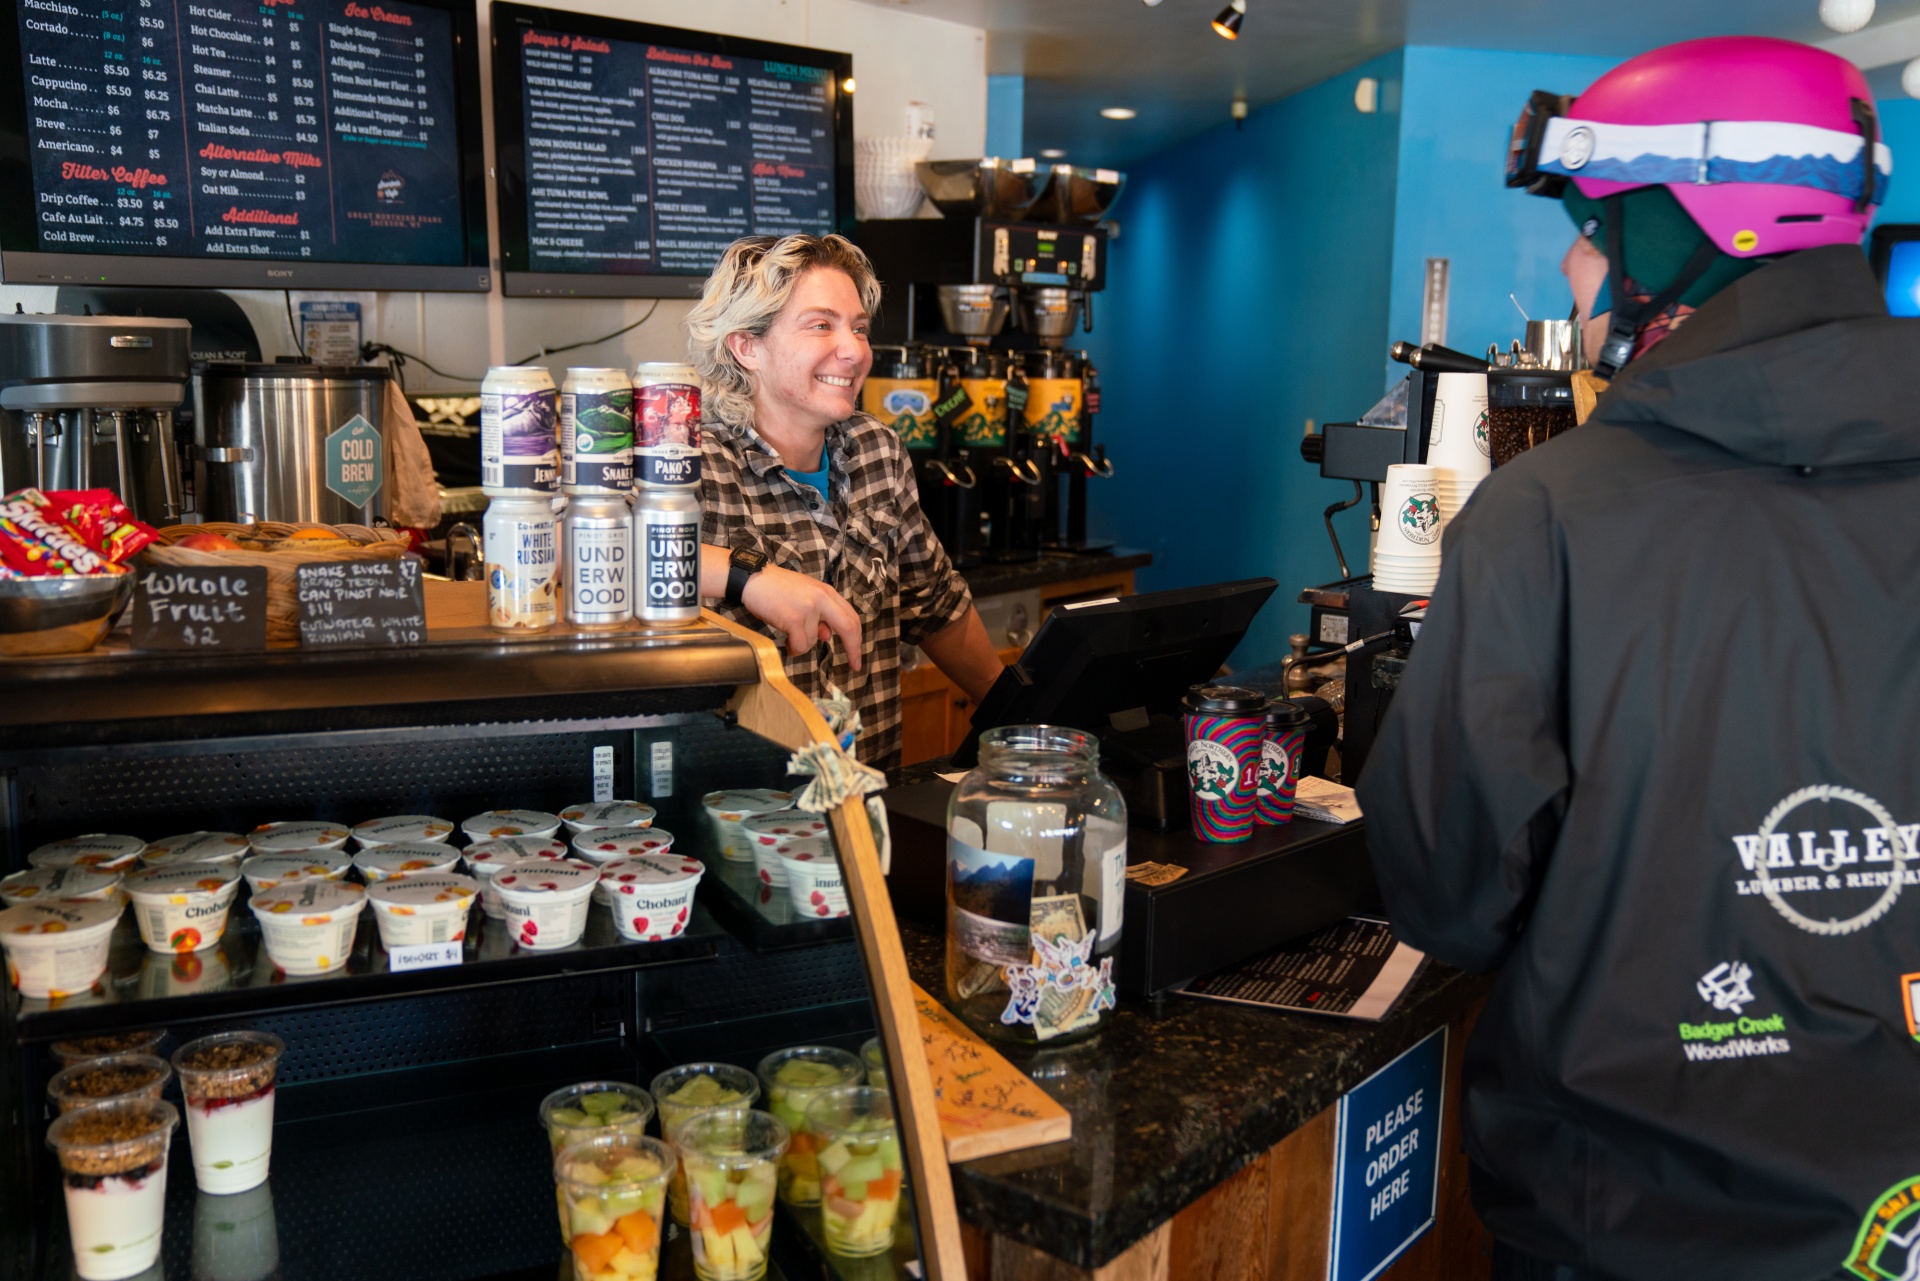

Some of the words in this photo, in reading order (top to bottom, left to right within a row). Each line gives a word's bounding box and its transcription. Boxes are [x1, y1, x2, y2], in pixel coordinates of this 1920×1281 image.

[24, 0, 79, 16] Macchiato
[140, 17, 164, 30] $5.50
[190, 5, 206, 16] Hot
[208, 8, 233, 21] Cider
[26, 20, 68, 35] Cortado
[142, 37, 154, 48] $6
[190, 25, 208, 36] Hot
[208, 28, 252, 44] Chocolate
[328, 22, 354, 36] Single
[354, 26, 378, 41] Scoop
[192, 44, 209, 56] Hot
[210, 48, 226, 58] Tea
[330, 40, 357, 52] Double
[358, 44, 381, 58] Scoop
[29, 54, 57, 68] Latte
[104, 64, 130, 77] $5.50
[142, 69, 168, 82] $6.25
[194, 63, 232, 78] Steamer
[331, 56, 366, 70] Affogato
[31, 76, 88, 92] Cappucino
[106, 85, 132, 98] $5.50
[144, 90, 170, 102] $6.25
[194, 83, 216, 95] Chai
[217, 86, 240, 98] Latte
[34, 96, 68, 110] Mocha
[108, 105, 120, 116] $6
[146, 110, 170, 122] $6.75
[196, 102, 230, 116] Matcha
[230, 106, 253, 118] Latte
[378, 94, 414, 108] Milkshake
[334, 106, 374, 120] Additional
[36, 118, 66, 130] Breve
[110, 126, 122, 136] $6
[148, 130, 160, 140] $7
[198, 122, 228, 134] Italian
[229, 125, 250, 136] Soda
[38, 138, 95, 154] Americano
[110, 145, 123, 156] $4
[149, 149, 161, 160] $5
[200, 142, 282, 164] Alternative
[62, 161, 110, 181] Filter
[111, 166, 168, 190] Coffee
[200, 166, 218, 179] Soy
[218, 169, 229, 177] or
[230, 169, 264, 181] Almond
[202, 184, 218, 194] Oat
[220, 185, 240, 196] Milk
[40, 192, 64, 206] Drip
[65, 194, 99, 206] Coffee
[117, 198, 144, 210] $3.50
[152, 200, 165, 210] $4
[42, 212, 66, 224] Cafe
[67, 214, 82, 224] Au
[84, 214, 104, 225] Lait
[119, 216, 144, 228] $4.75
[154, 218, 179, 230] $5.50
[222, 206, 299, 226] Additional
[44, 231, 68, 242] Cold
[69, 232, 95, 243] Brew
[156, 236, 168, 246] $5
[205, 225, 223, 236] Add
[224, 226, 248, 237] Extra
[249, 228, 276, 239] Flavor
[206, 243, 224, 254] Add
[226, 244, 248, 254] Extra
[250, 244, 270, 255] Shot
[342, 439, 374, 461] COLD
[342, 462, 374, 483] BREW
[602, 466, 629, 482] SNAKE
[654, 460, 692, 474] PAKO'S
[664, 474, 684, 482] I.P.A.
[579, 532, 604, 540] PINOT
[651, 526, 677, 534] PINOT
[1402, 526, 1430, 543] NORTHERN
[522, 532, 552, 548] WHITE
[650, 540, 696, 558] UND
[579, 546, 625, 562] UND
[299, 564, 346, 580] SNAKE
[352, 562, 393, 576] RIVER
[400, 561, 418, 577] $7
[580, 567, 625, 584] ERW
[650, 560, 696, 578] ERW
[140, 571, 249, 597] Whole
[300, 578, 343, 590] GRAND
[346, 577, 386, 588] TETON
[650, 582, 696, 599] OOD
[299, 589, 330, 602] CAN
[335, 587, 374, 600] PINOT
[378, 587, 408, 600] NOIR
[579, 588, 625, 604] OOD
[148, 598, 246, 624] Fruit
[307, 602, 334, 617] $14
[380, 616, 424, 628] WHITE
[182, 625, 220, 646] $2
[308, 630, 366, 644] RUSSIAN
[387, 630, 420, 643] $10
[1200, 741, 1234, 762] NORTHERN
[1262, 740, 1286, 759] RTHERN
[1732, 824, 1920, 870] VALLEY
[512, 867, 580, 877] Chobani
[1736, 875, 1821, 895] LUMBER
[1825, 873, 1842, 890] &
[1846, 869, 1920, 889] RENTA
[636, 892, 688, 910] Chobani
[1679, 1020, 1736, 1042] Badger
[1737, 1014, 1786, 1036] Creek
[1683, 1036, 1791, 1062] WoodWorks
[1364, 1088, 1424, 1152] PLEASE
[1365, 1128, 1420, 1188] ORDER
[1369, 1168, 1411, 1222] HERE
